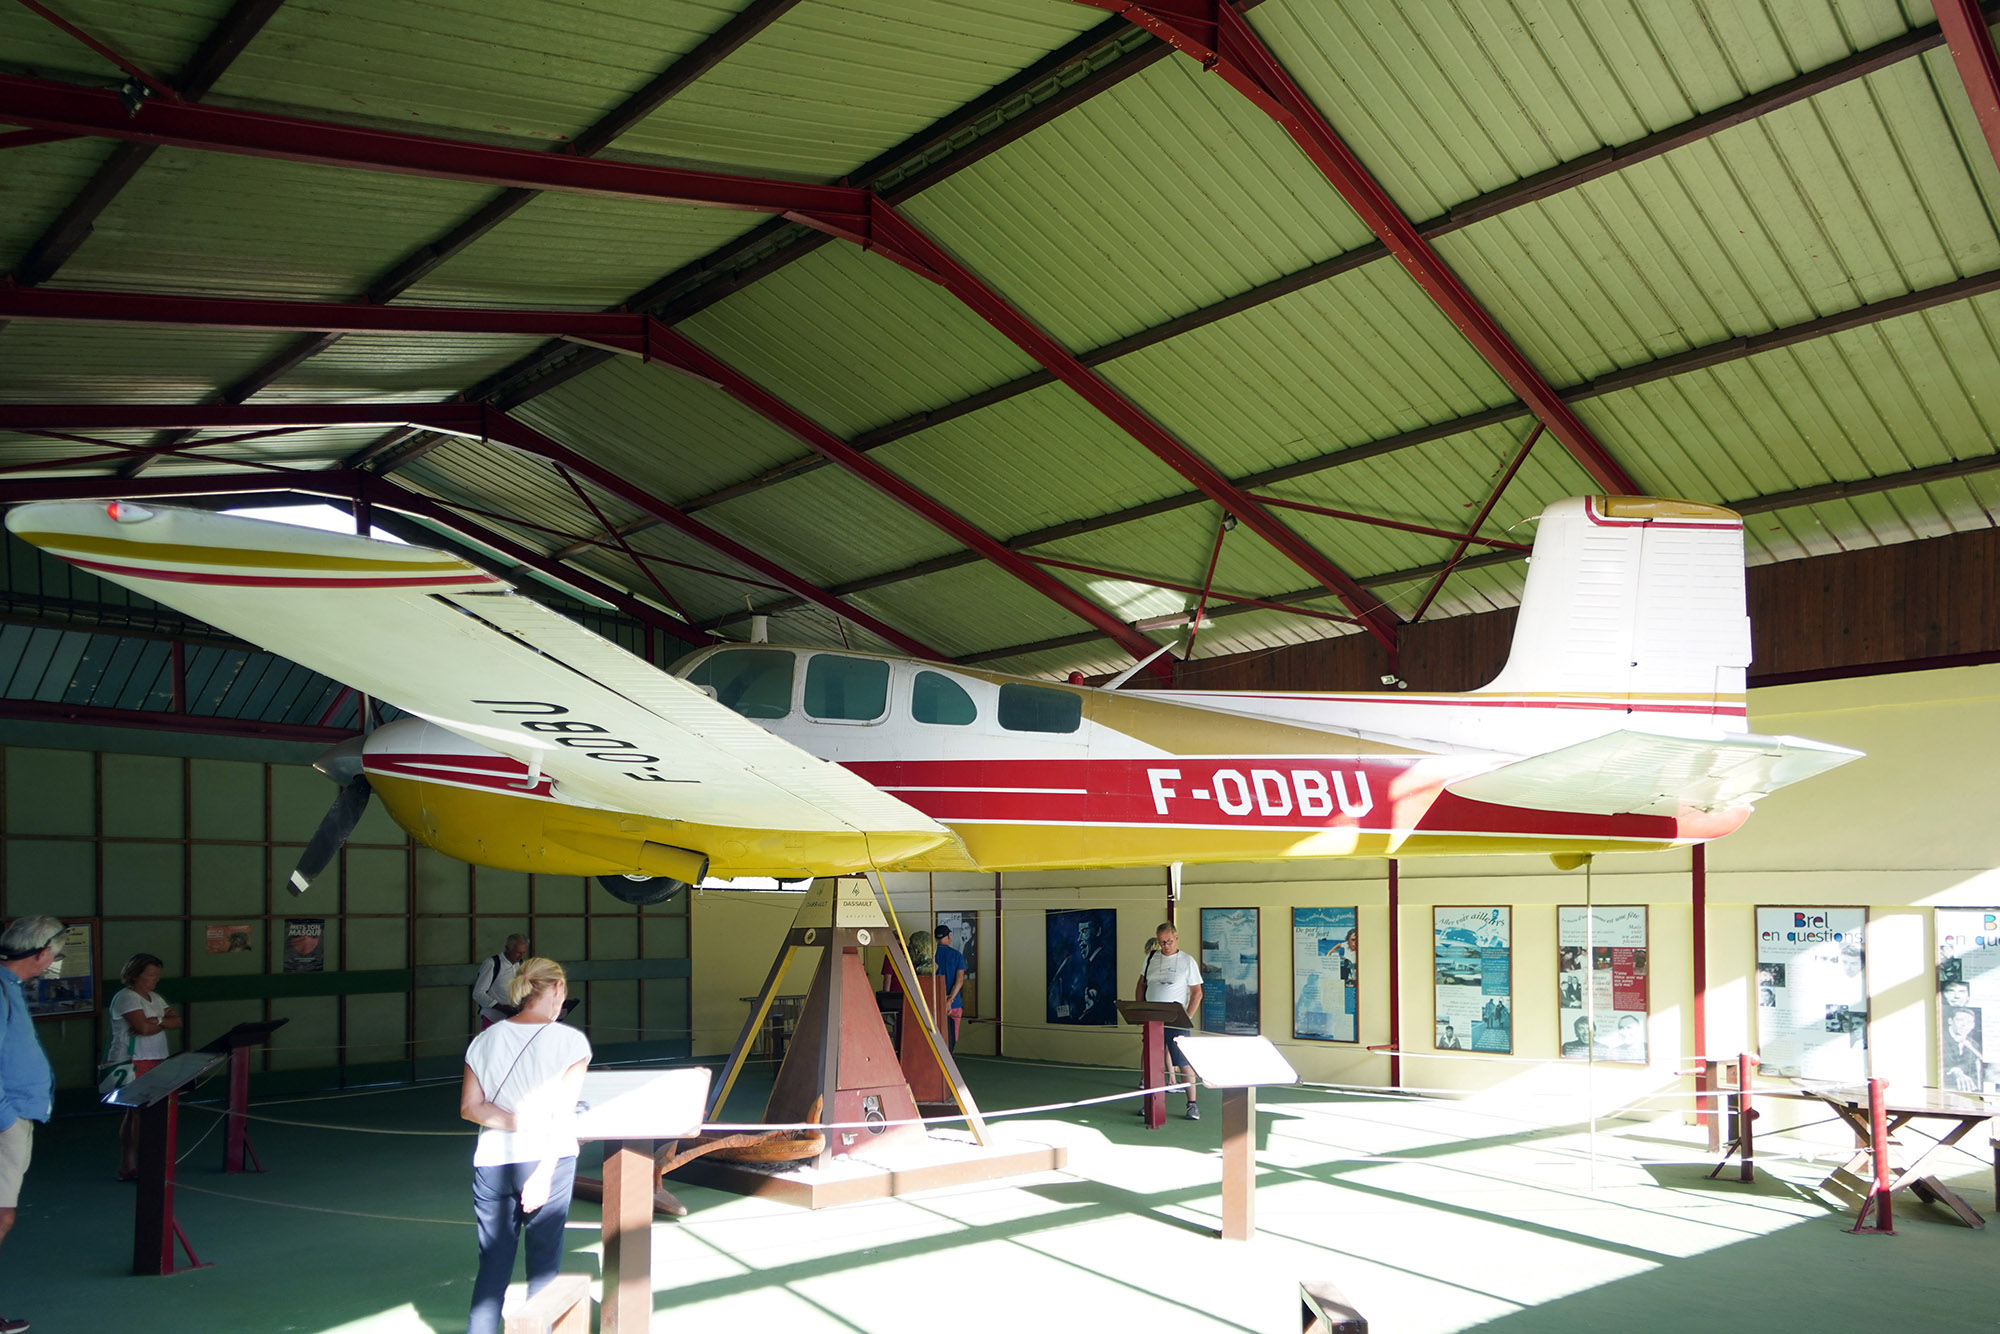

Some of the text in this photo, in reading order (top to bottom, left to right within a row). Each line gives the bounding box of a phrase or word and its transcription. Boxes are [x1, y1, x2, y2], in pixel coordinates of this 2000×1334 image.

[470, 700, 701, 784] F-ODBU
[1147, 768, 1374, 818] F-ODBU
[1794, 912, 1830, 929] Brel
[1984, 914, 2000, 931] B
[1762, 929, 1863, 945] en questions
[1975, 935, 2000, 950] qu
